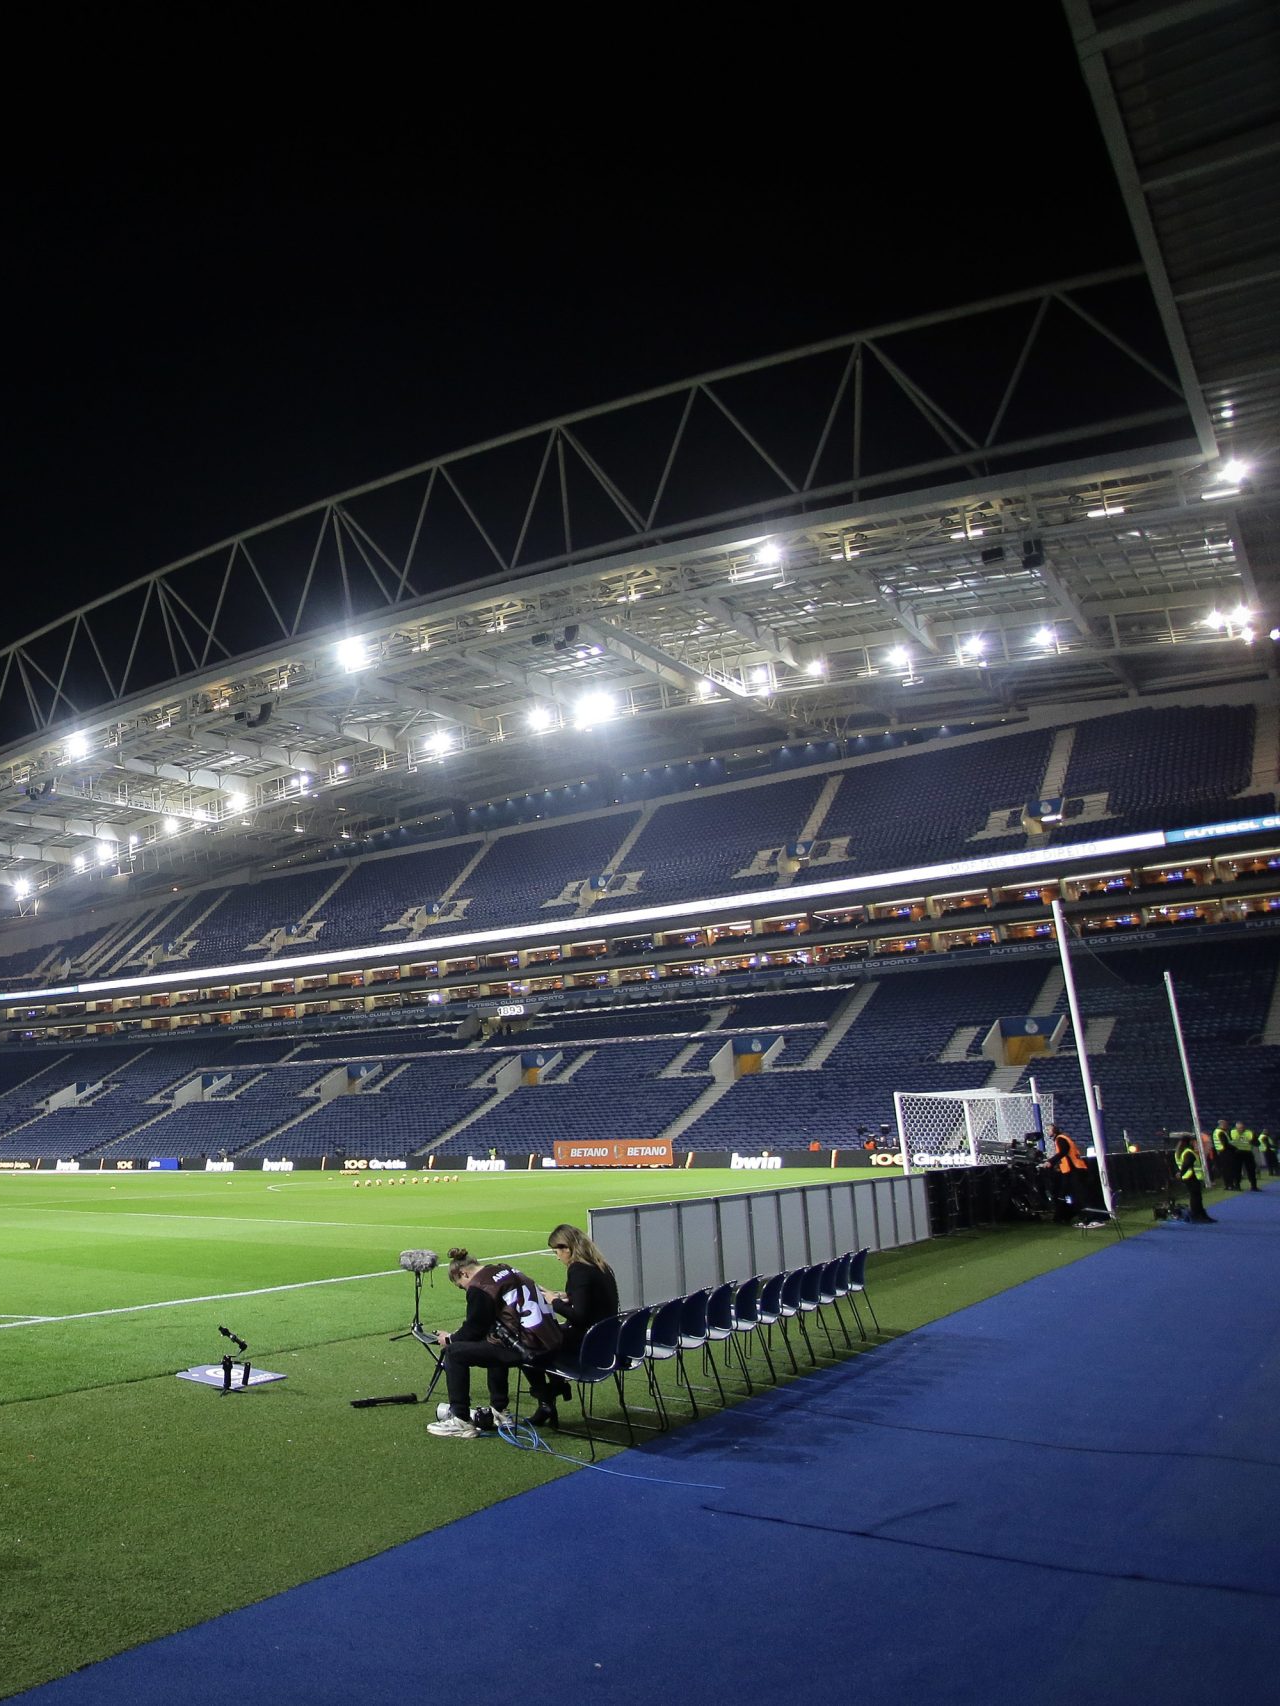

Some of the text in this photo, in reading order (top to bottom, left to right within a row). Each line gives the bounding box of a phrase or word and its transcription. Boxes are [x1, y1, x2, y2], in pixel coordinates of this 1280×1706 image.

[1090, 937, 1107, 945] DO
[1110, 932, 1157, 943] PORTO
[784, 967, 828, 976] FUTEBOL
[830, 964, 863, 972] CLUBE
[882, 957, 919, 966] PORTO
[613, 986, 650, 994] FUTEBOL
[695, 978, 726, 986] PORTO
[497, 1005, 525, 1017] 1893
[570, 1146, 667, 1157] BETANO BETANO
[262, 1157, 294, 1171] bwin
[466, 1155, 506, 1171] bwin
[730, 1151, 782, 1170] bwin
